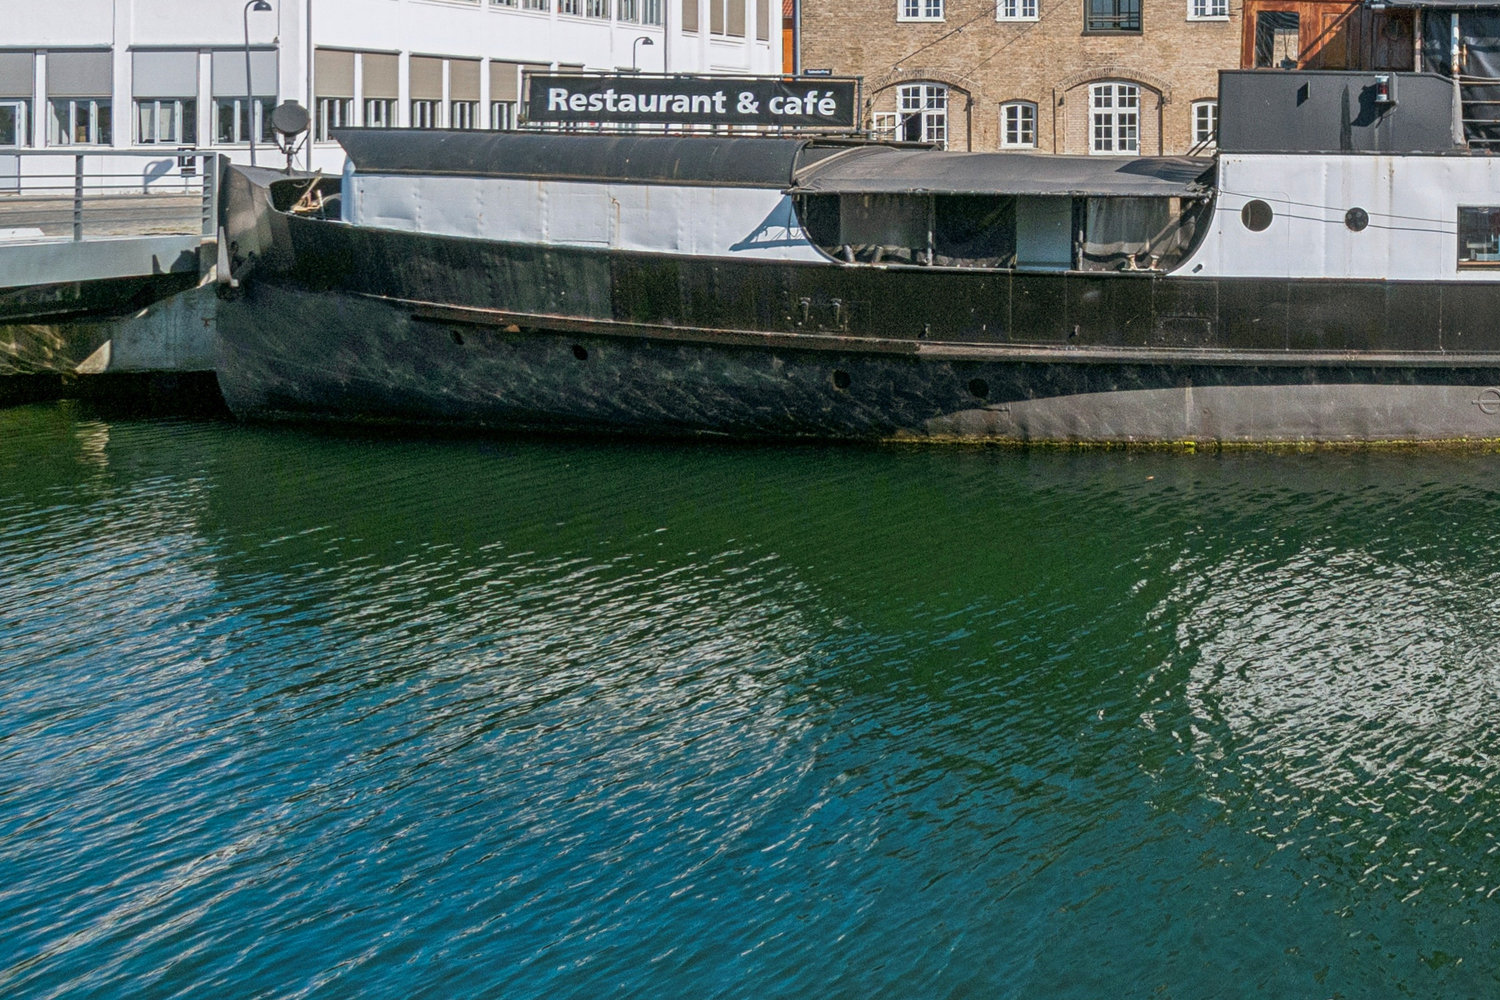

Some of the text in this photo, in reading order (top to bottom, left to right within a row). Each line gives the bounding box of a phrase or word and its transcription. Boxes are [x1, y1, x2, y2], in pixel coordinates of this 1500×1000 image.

[548, 87, 837, 116] Restaurant & café
[184, 149, 193, 165] P
